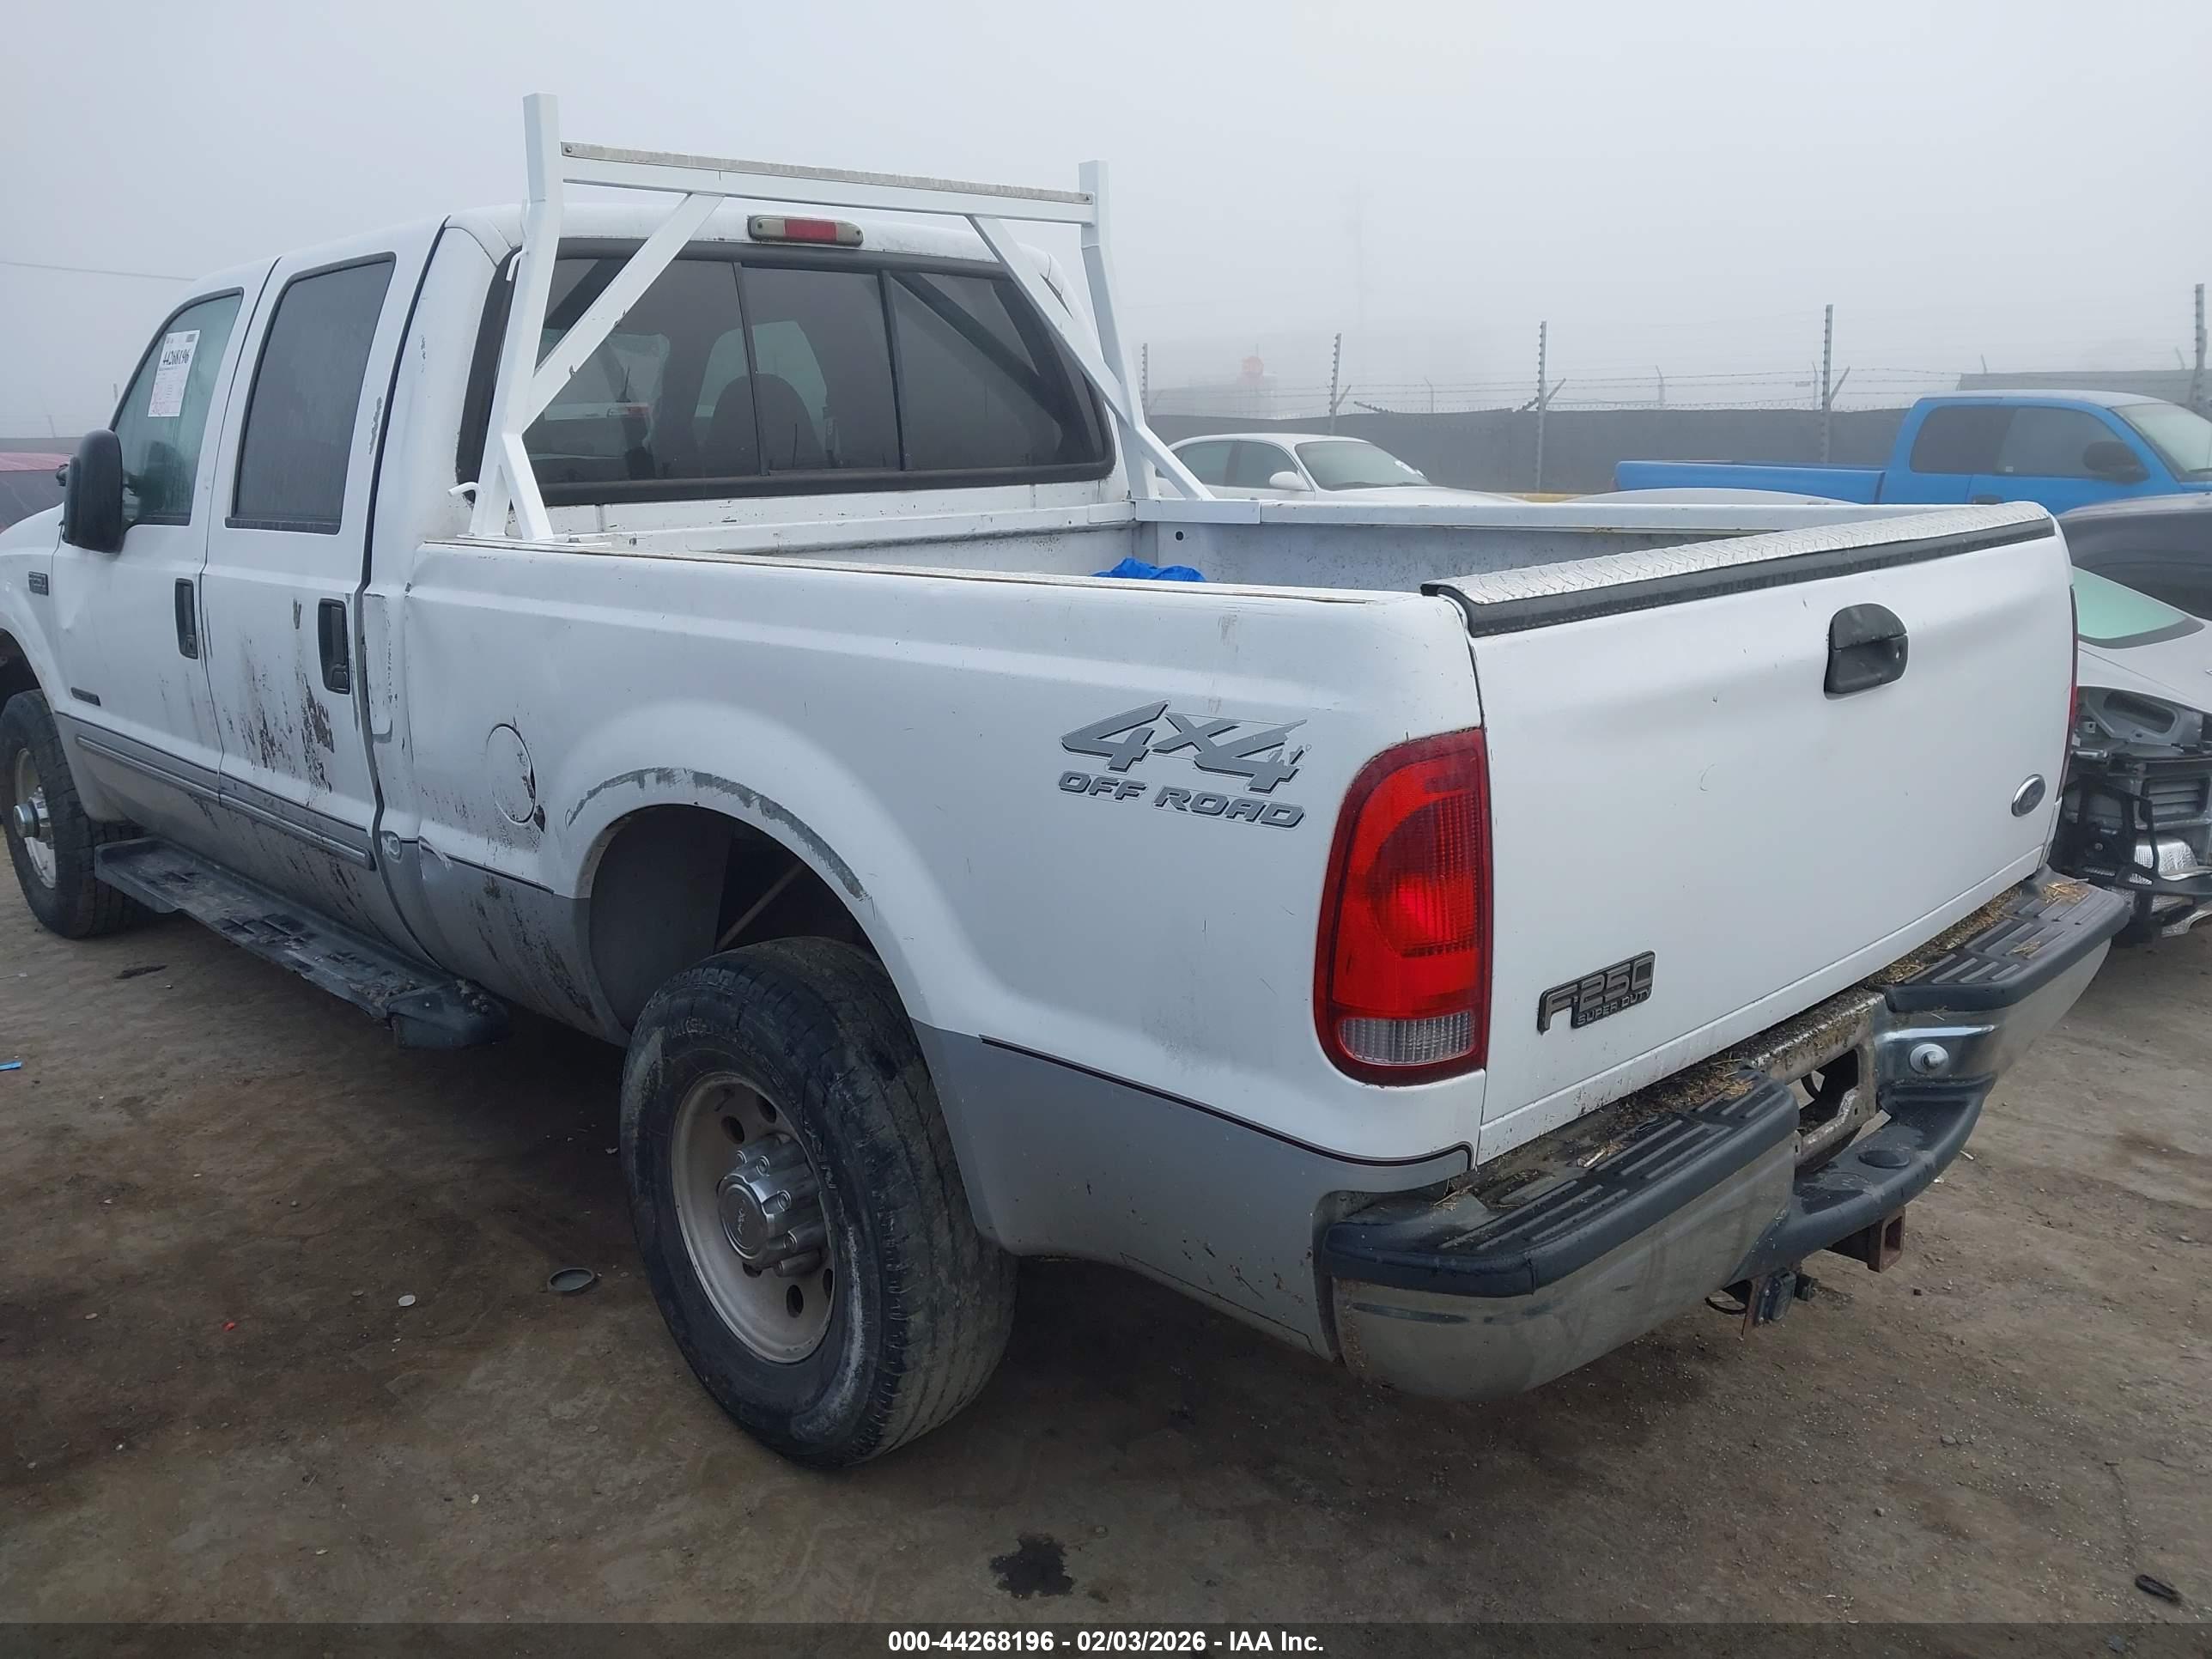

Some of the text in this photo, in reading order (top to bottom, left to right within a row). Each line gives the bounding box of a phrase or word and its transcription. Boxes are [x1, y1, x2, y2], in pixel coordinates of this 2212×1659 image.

[1058, 771, 1306, 829] OFF ROAD
[1577, 988, 1652, 1025] SUPER DUTY
